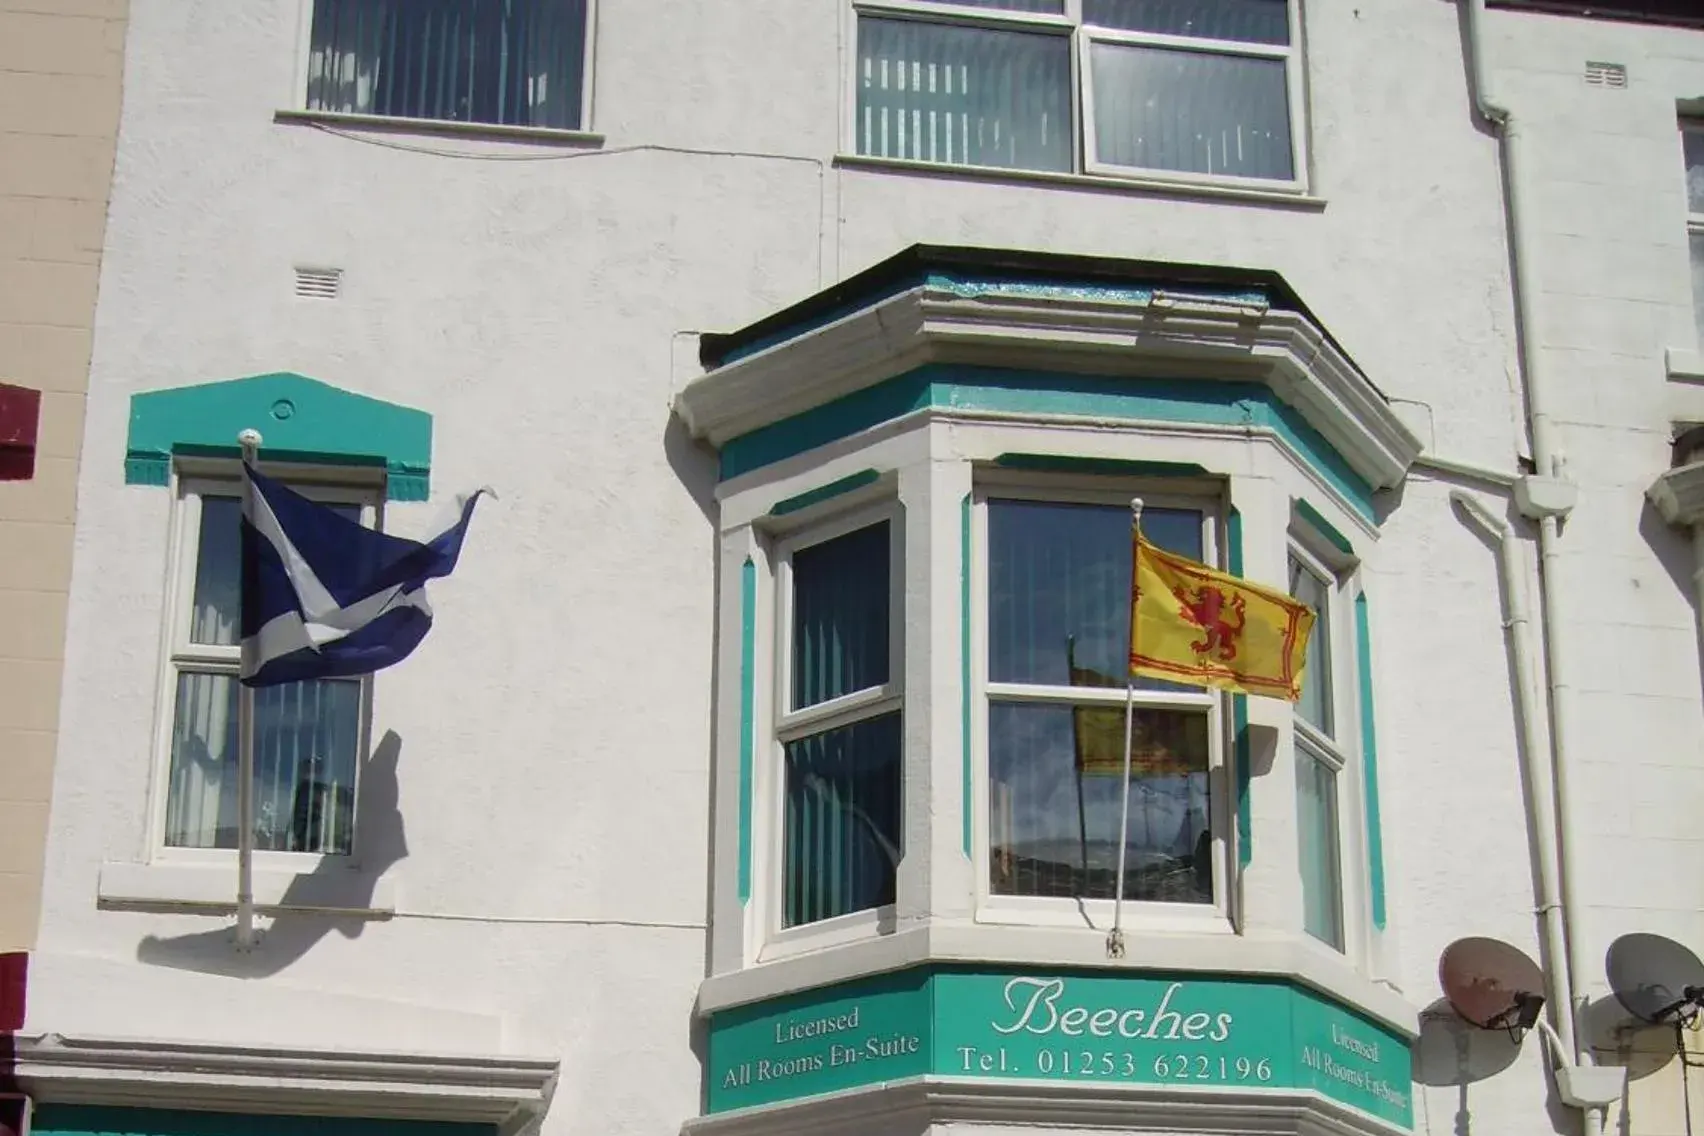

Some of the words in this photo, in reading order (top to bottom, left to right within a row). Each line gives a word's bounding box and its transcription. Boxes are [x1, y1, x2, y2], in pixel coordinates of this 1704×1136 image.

[774, 1006, 859, 1044] Licensed
[991, 976, 1232, 1042] Beeches
[723, 1062, 751, 1088] All
[758, 1053, 824, 1082] Rooms
[829, 1033, 920, 1067] En-Suite
[957, 1047, 1018, 1072] Tel.
[1037, 1050, 1136, 1077] 01253
[1153, 1054, 1272, 1081] 622196
[1331, 1023, 1379, 1063] Licensed
[1301, 1045, 1321, 1071] All
[1323, 1052, 1363, 1088] Rooms
[1363, 1070, 1407, 1109] En-Su
